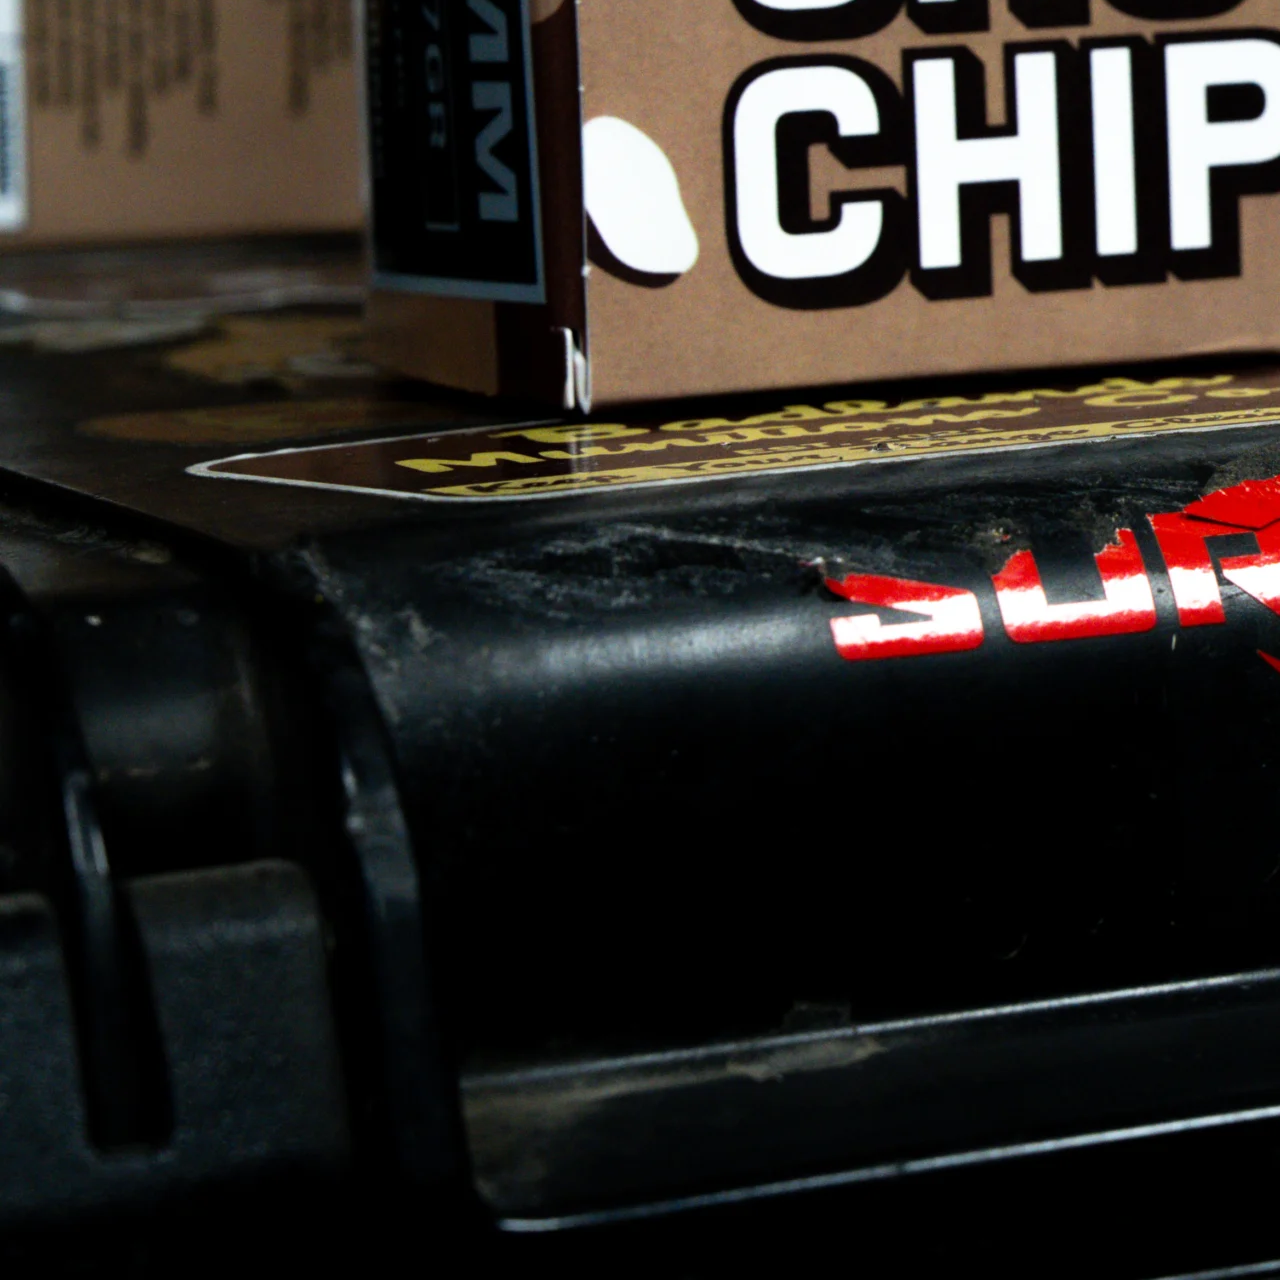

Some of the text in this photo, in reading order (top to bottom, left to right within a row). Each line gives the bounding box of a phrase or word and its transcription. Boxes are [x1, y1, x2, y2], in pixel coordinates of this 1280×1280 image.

[395, 406, 1041, 474] Munitions
[465, 472, 637, 495] Keep
[652, 453, 839, 472] Your
[851, 429, 1089, 452] Range
